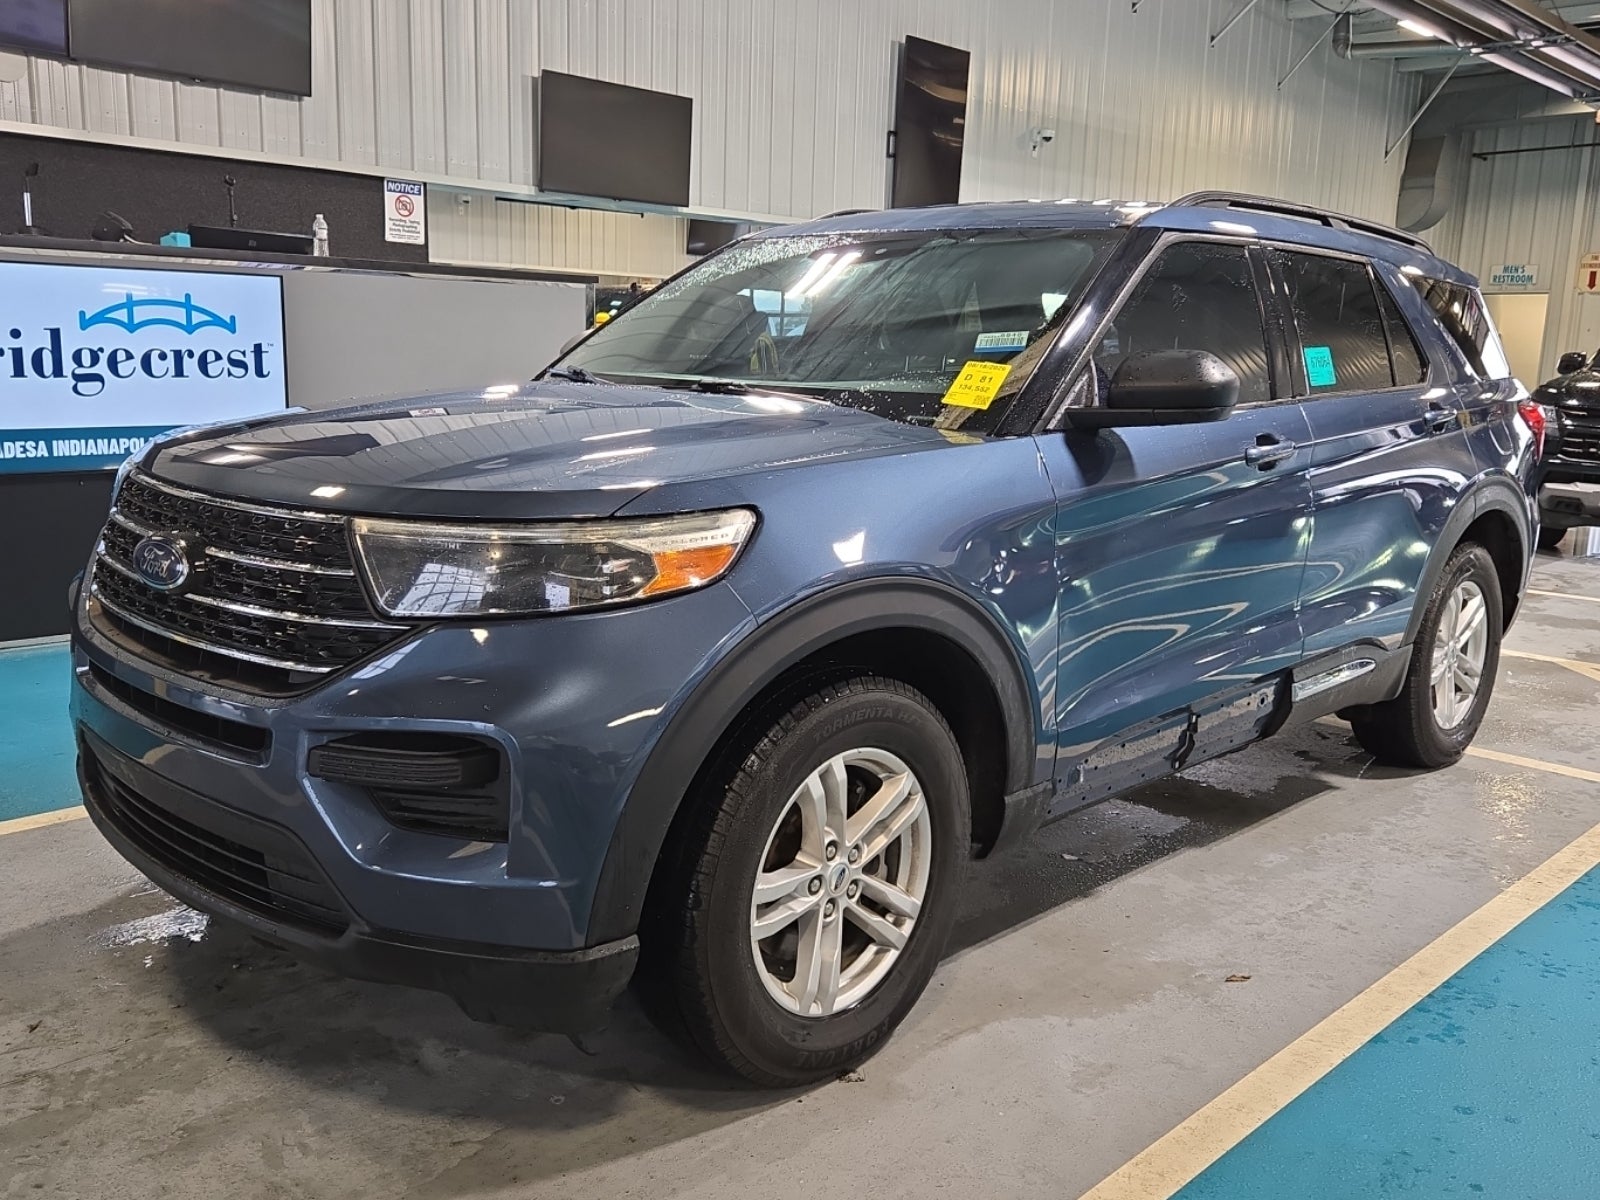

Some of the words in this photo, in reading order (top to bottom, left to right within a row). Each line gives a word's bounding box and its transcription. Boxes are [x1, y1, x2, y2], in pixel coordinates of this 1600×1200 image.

[387, 181, 421, 194] NOTICE
[1492, 274, 1534, 283] RESTROOM
[0, 326, 271, 397] idgecrest
[964, 373, 973, 381] D
[0, 440, 49, 459] DESA
[140, 545, 172, 578] Ford
